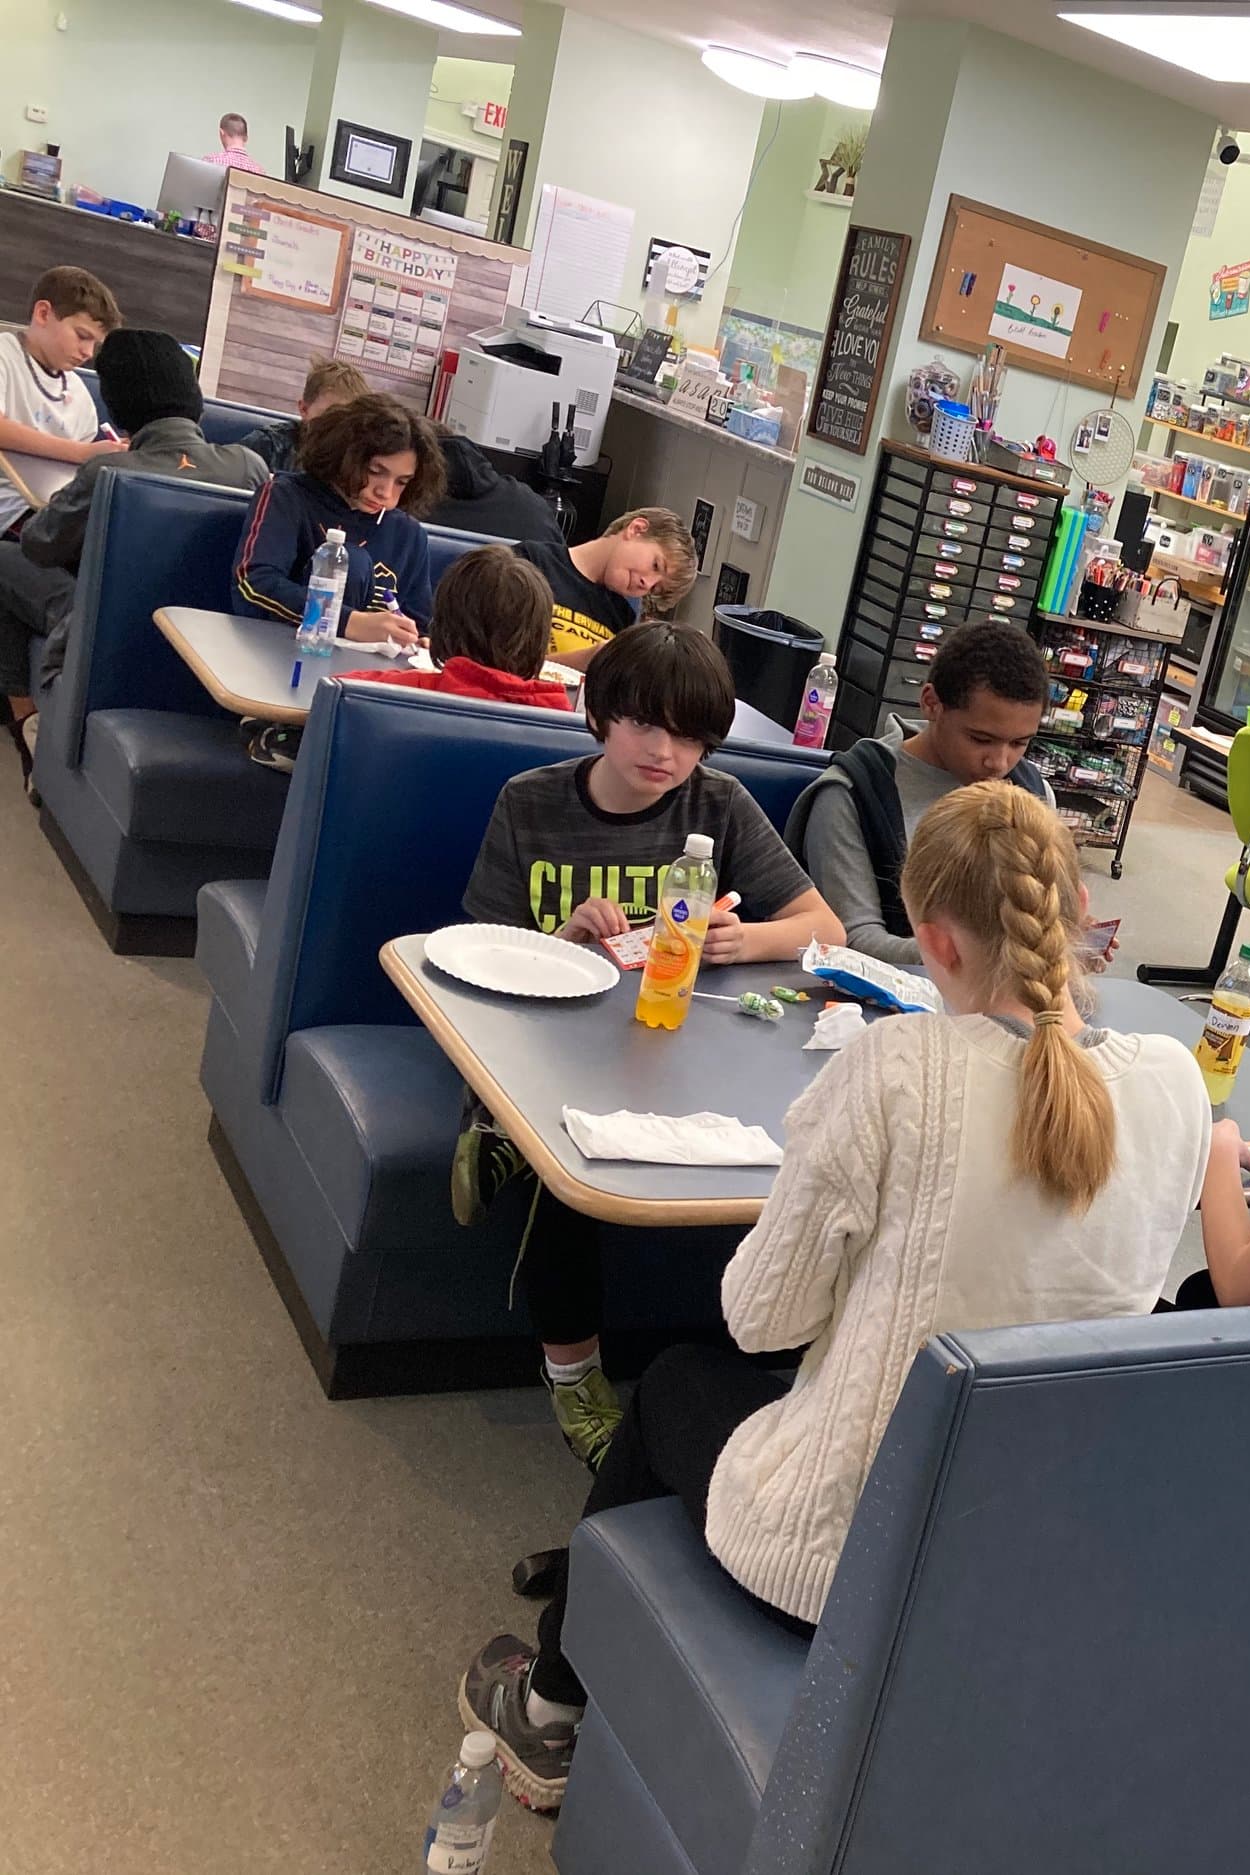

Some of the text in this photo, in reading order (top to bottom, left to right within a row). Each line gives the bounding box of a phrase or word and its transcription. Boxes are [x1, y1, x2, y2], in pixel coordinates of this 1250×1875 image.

[484, 102, 506, 128] EXI
[380, 240, 432, 264] HAPPY
[861, 235, 897, 255] FAMILY
[364, 248, 444, 281] BIRTHDAY
[849, 252, 897, 284] RULES
[843, 294, 889, 328] Grateful
[838, 332, 864, 357] LOVE
[552, 622, 598, 645] CAUT
